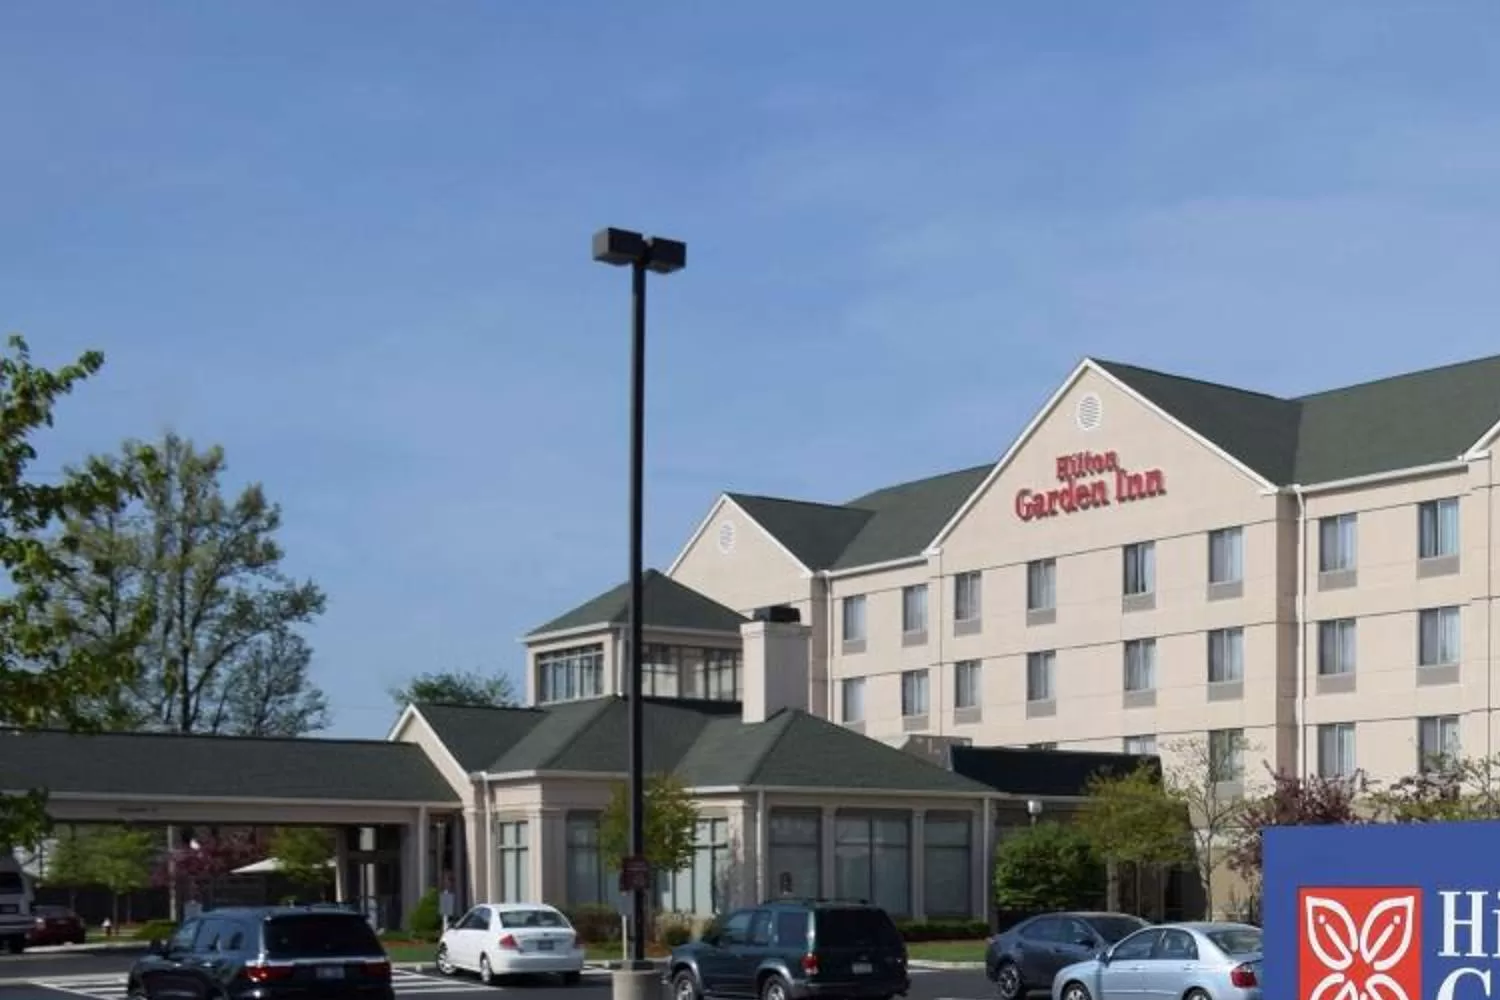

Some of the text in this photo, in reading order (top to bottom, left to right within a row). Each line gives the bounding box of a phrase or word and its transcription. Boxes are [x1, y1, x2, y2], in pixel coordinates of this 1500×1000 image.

[1056, 450, 1119, 480] Hilton
[1015, 468, 1167, 522] Garden Inn
